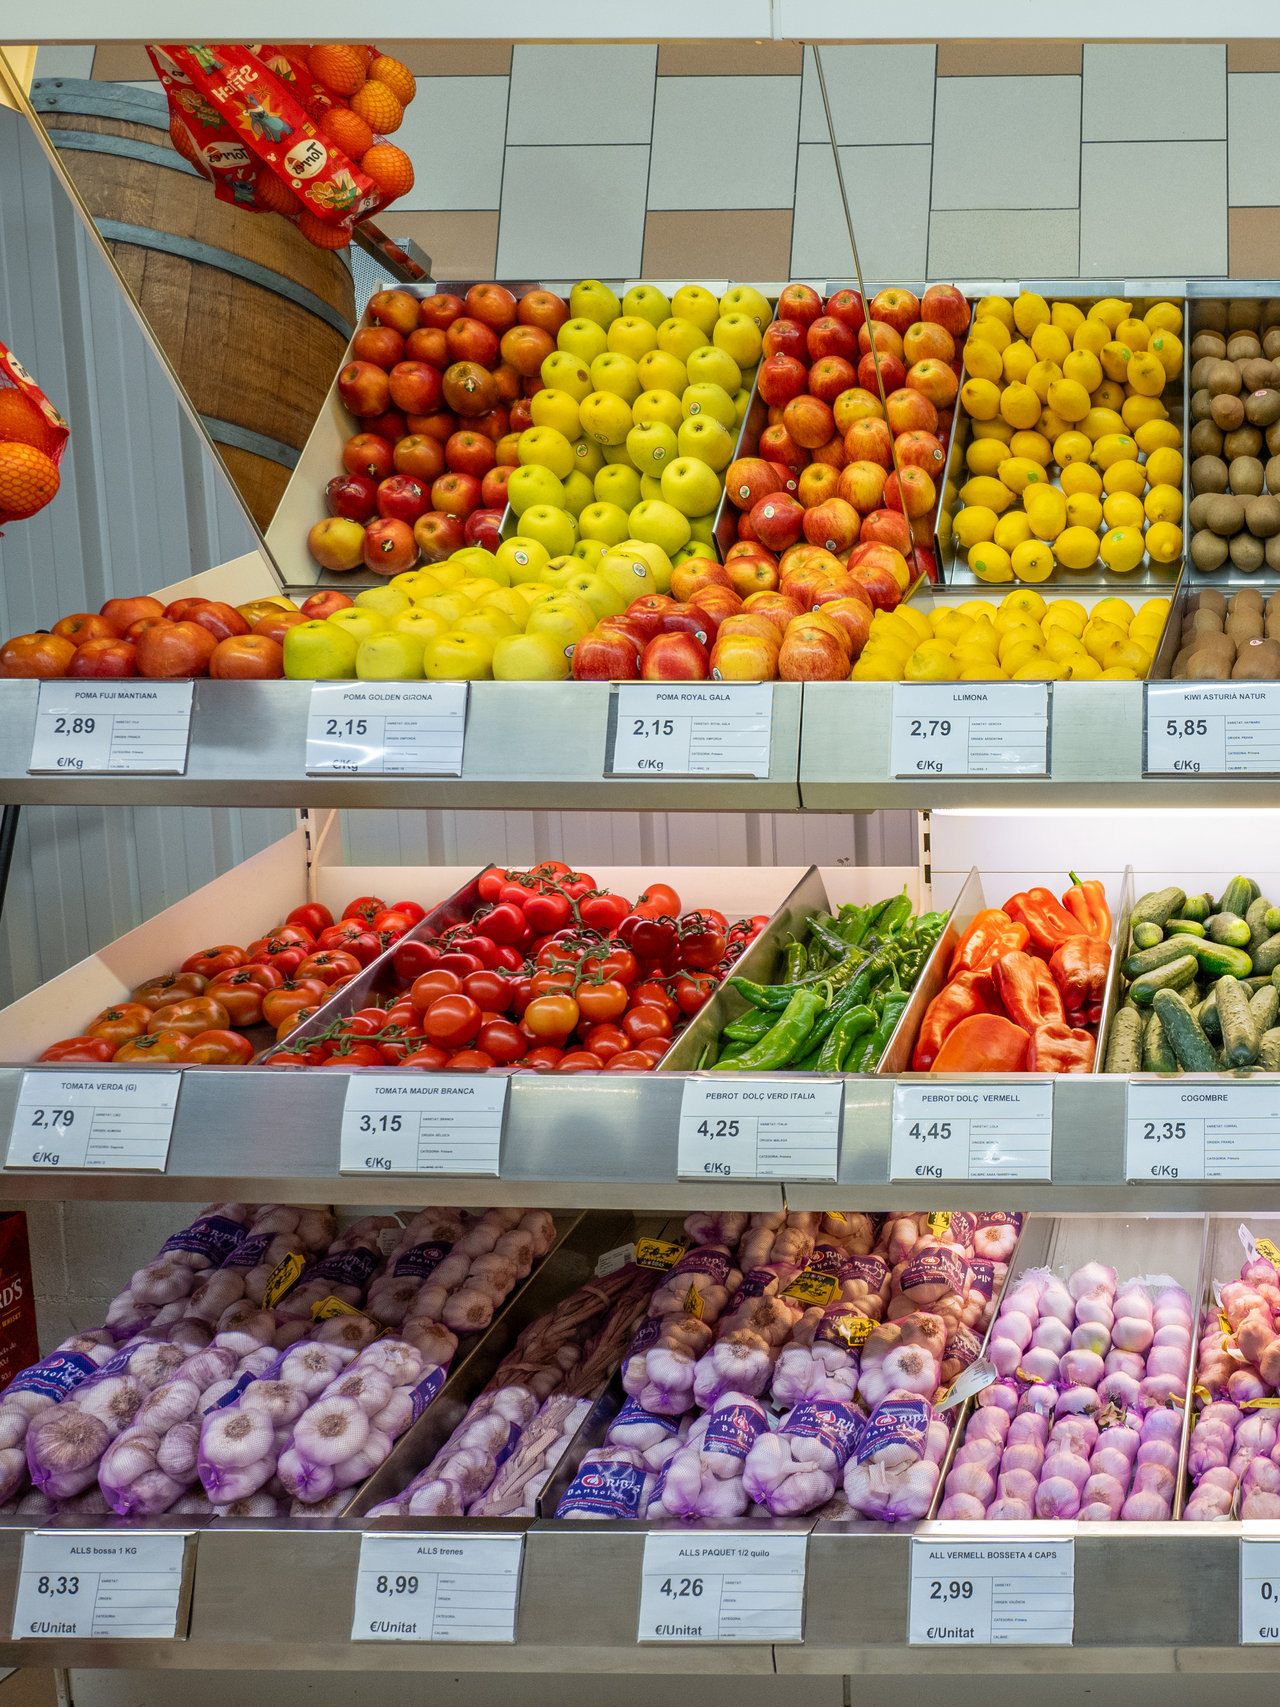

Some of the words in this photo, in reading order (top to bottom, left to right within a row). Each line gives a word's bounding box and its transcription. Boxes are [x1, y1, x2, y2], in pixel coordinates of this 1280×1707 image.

[54, 718, 95, 736] 2,89
[326, 720, 367, 737] 2,15
[633, 720, 673, 738] 2,15
[911, 721, 951, 738] 2,79
[1167, 720, 1207, 738] 5,85
[57, 758, 83, 769] €/Kg
[638, 760, 663, 771] €/Kg
[917, 761, 943, 772] €/Kg
[1174, 760, 1200, 772] €/Kg
[32, 1110, 74, 1129] 2,79
[360, 1115, 401, 1134] 3,15
[698, 1120, 739, 1140] 4,25
[910, 1123, 951, 1142] 4,45
[1144, 1123, 1186, 1142] 2,35
[33, 1152, 59, 1164] €/Kg
[365, 1158, 391, 1170] €/Kg
[704, 1163, 731, 1175] €/Kg
[915, 1166, 942, 1178] €/Kg
[1151, 1166, 1178, 1178] €/Kg
[38, 1576, 79, 1597] 8,33
[376, 1576, 418, 1596] 8,99
[660, 1578, 703, 1600] 4,26
[930, 1581, 973, 1602] 2,99
[30, 1622, 76, 1633] €/Unitat
[370, 1621, 416, 1633] €/Unitat
[656, 1625, 702, 1636] €/Unitat
[927, 1628, 974, 1638] €/Unitat
